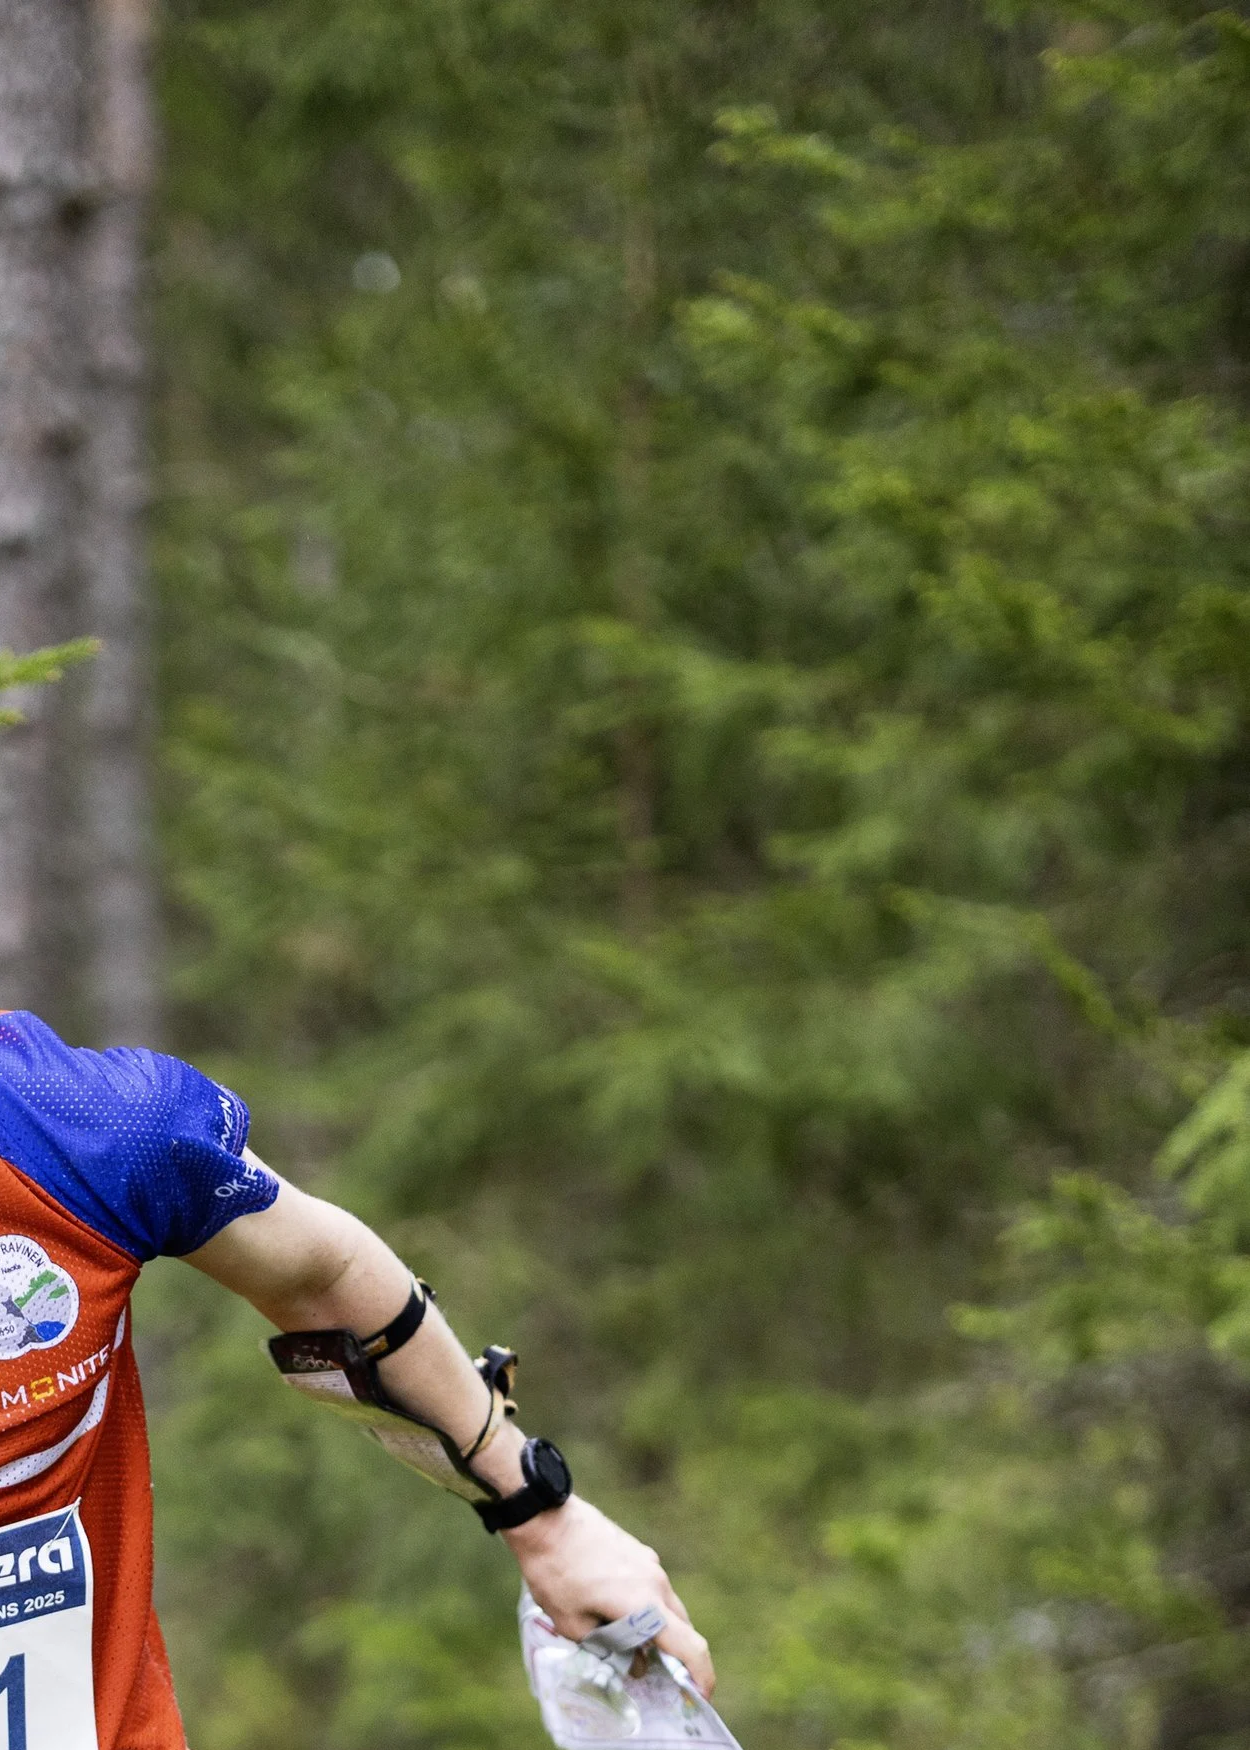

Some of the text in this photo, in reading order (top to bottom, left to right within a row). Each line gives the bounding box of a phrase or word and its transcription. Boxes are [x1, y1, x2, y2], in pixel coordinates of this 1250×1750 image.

[214, 1178, 250, 1198] OK
[0, 1242, 46, 1268] RAVINEN
[23, 1589, 66, 1614] 2025
